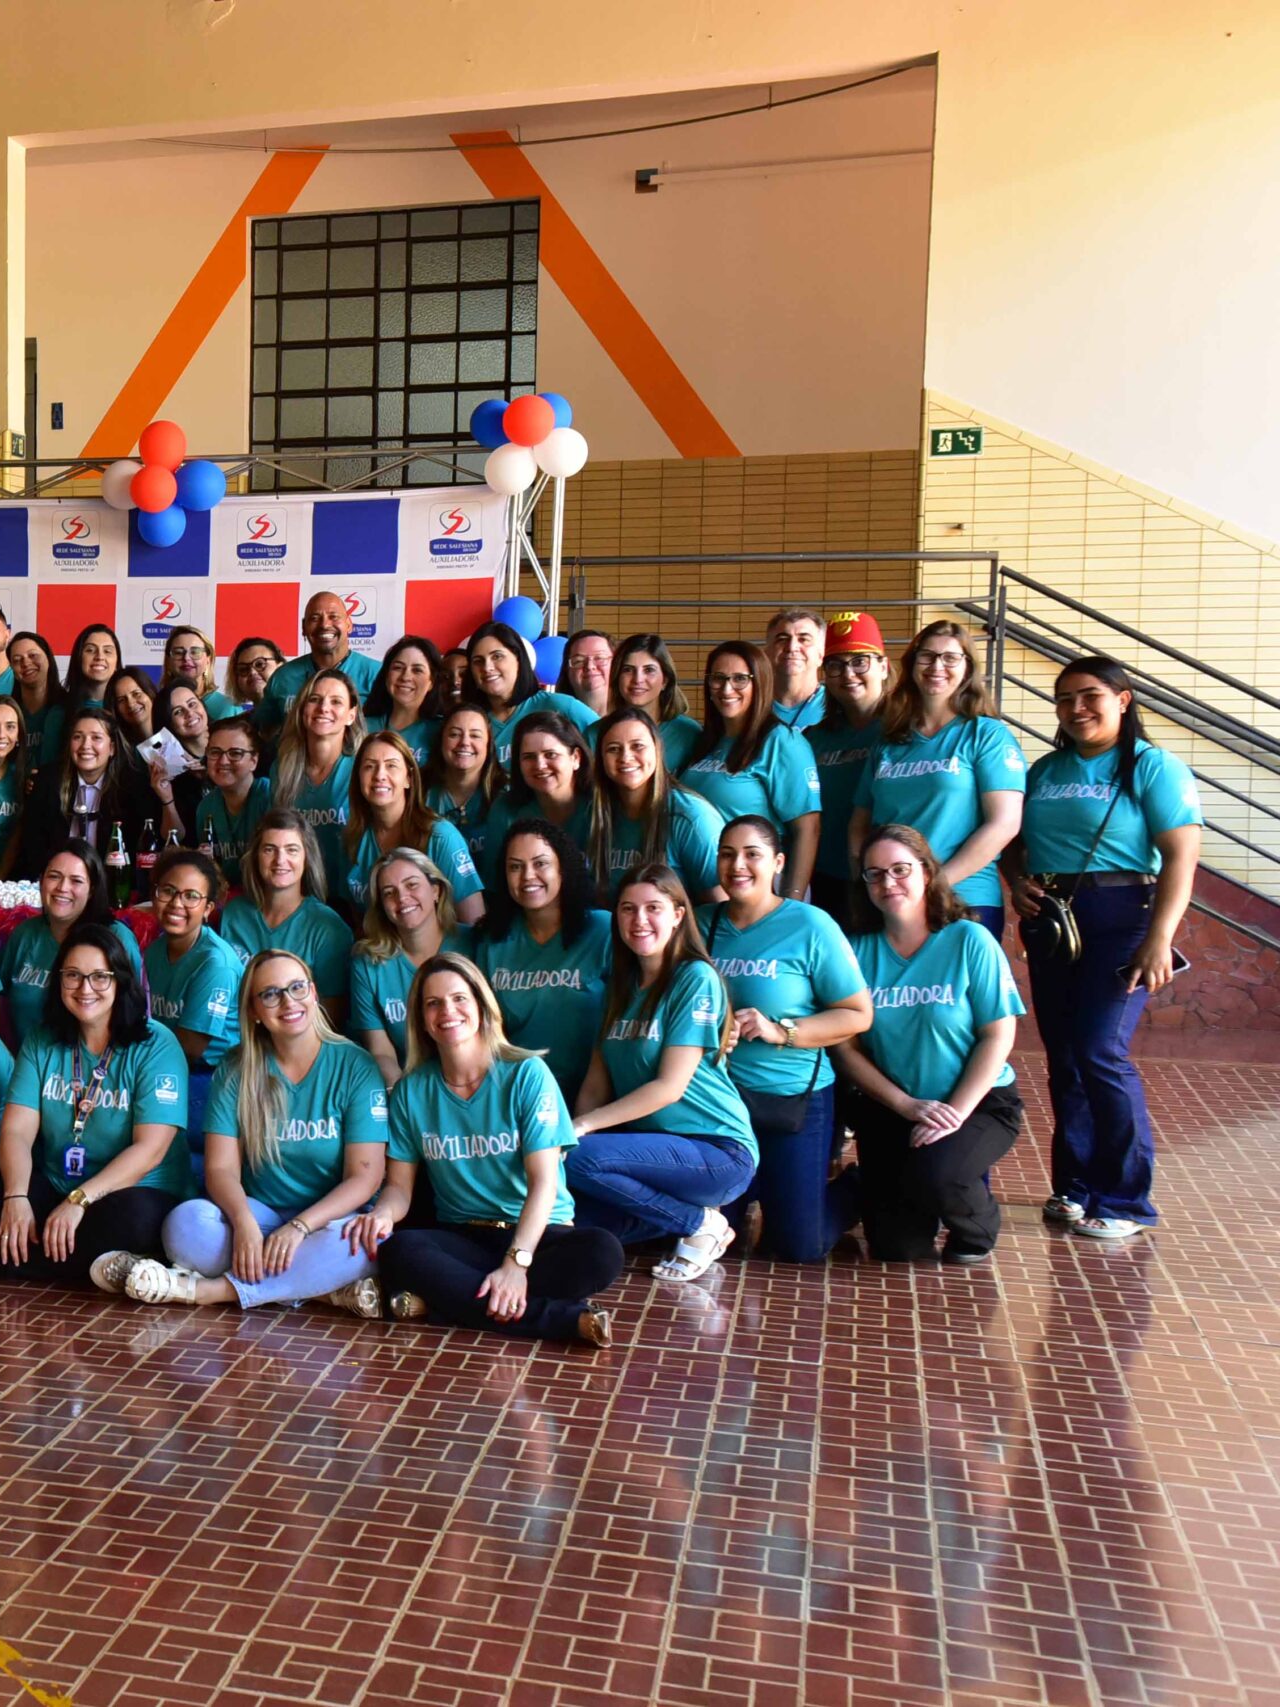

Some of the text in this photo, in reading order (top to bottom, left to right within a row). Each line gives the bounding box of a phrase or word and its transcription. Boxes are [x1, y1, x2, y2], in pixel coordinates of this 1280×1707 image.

[429, 555, 480, 563] AUXILIADORA
[868, 984, 955, 1008] XILIADORA
[422, 1130, 520, 1161] AUXILIADORA
